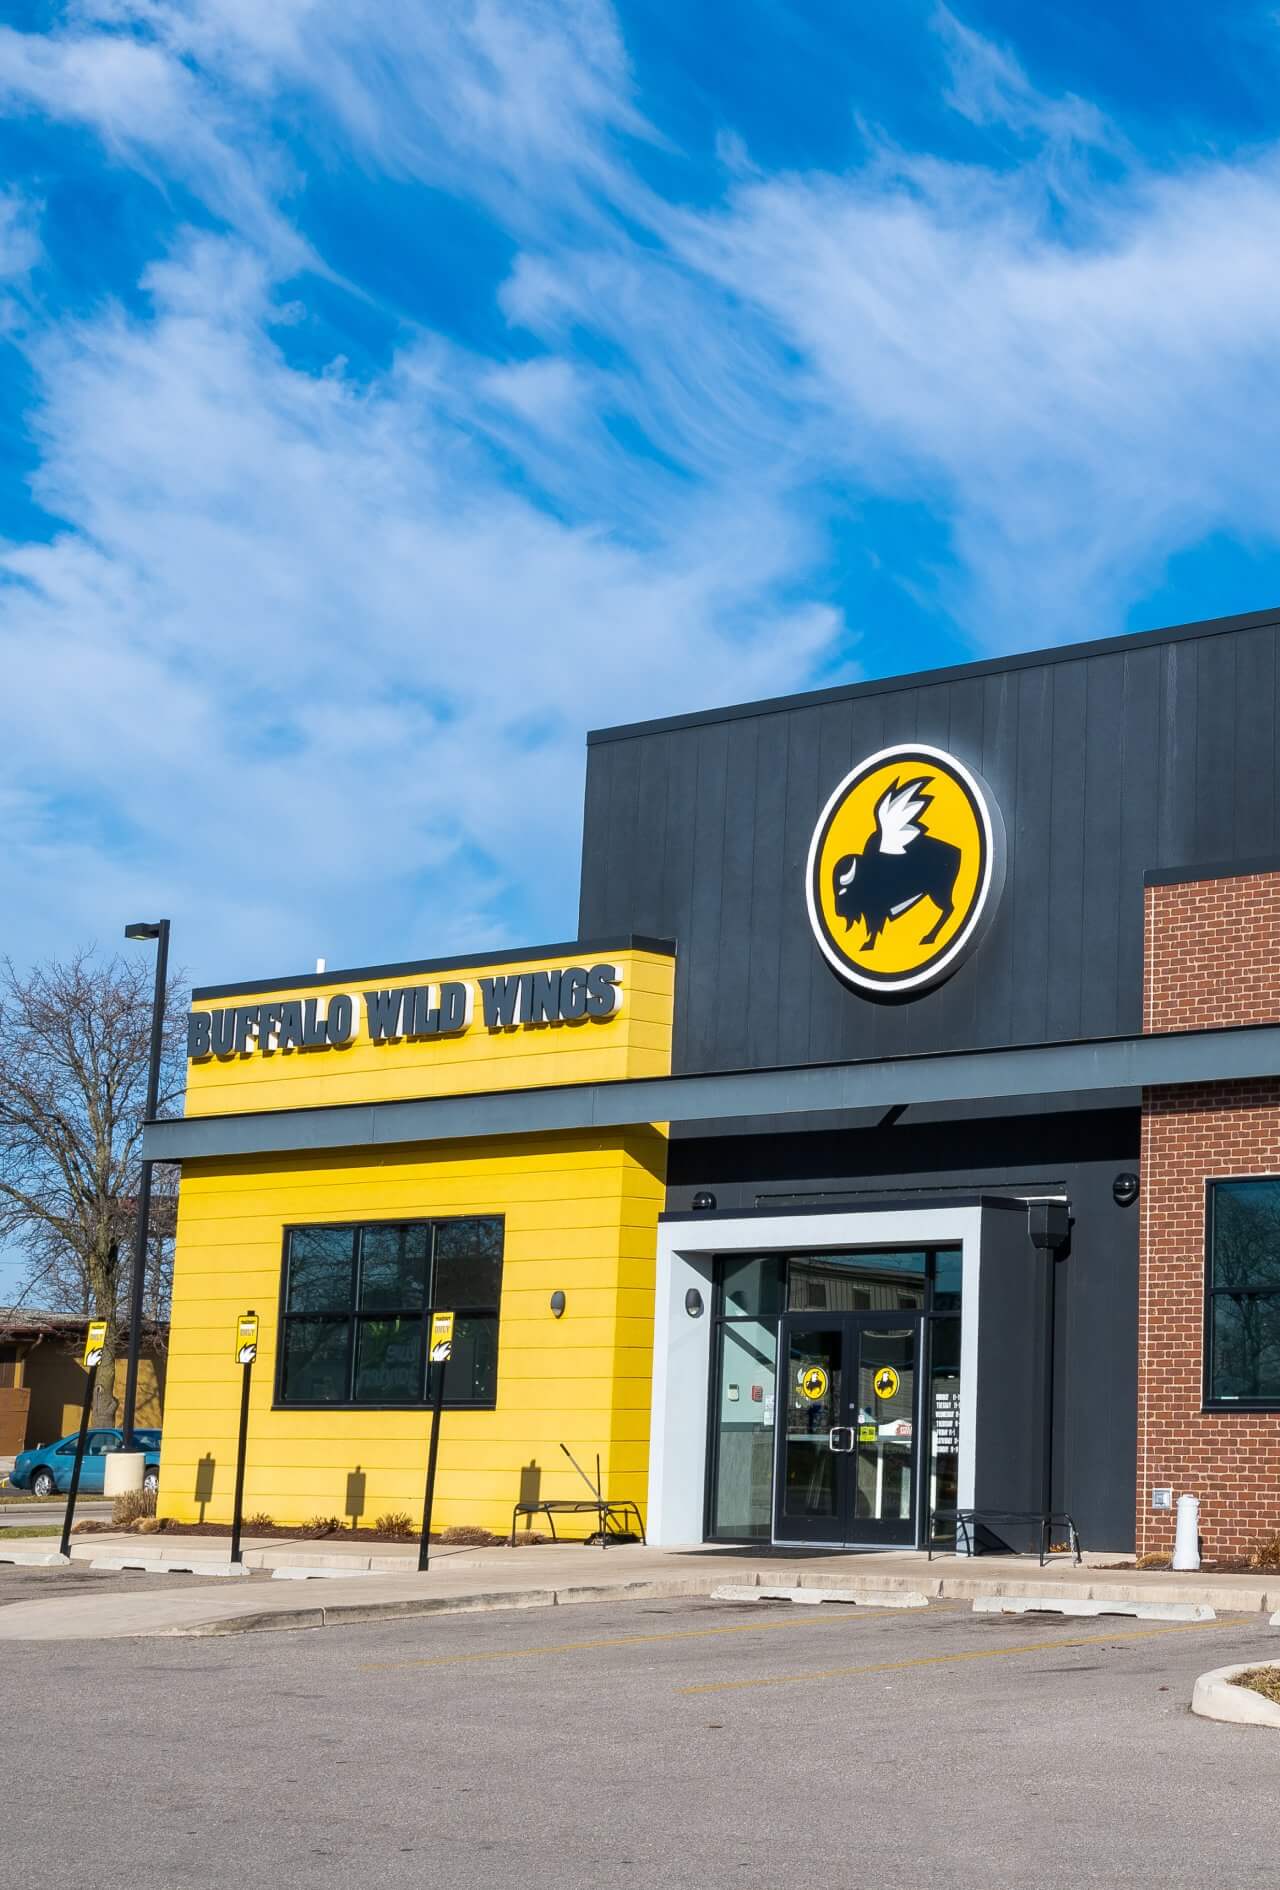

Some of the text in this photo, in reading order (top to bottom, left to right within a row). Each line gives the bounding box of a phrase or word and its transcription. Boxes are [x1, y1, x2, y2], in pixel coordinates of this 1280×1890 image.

[187, 963, 618, 1057] BUFFALO WILD WINGS
